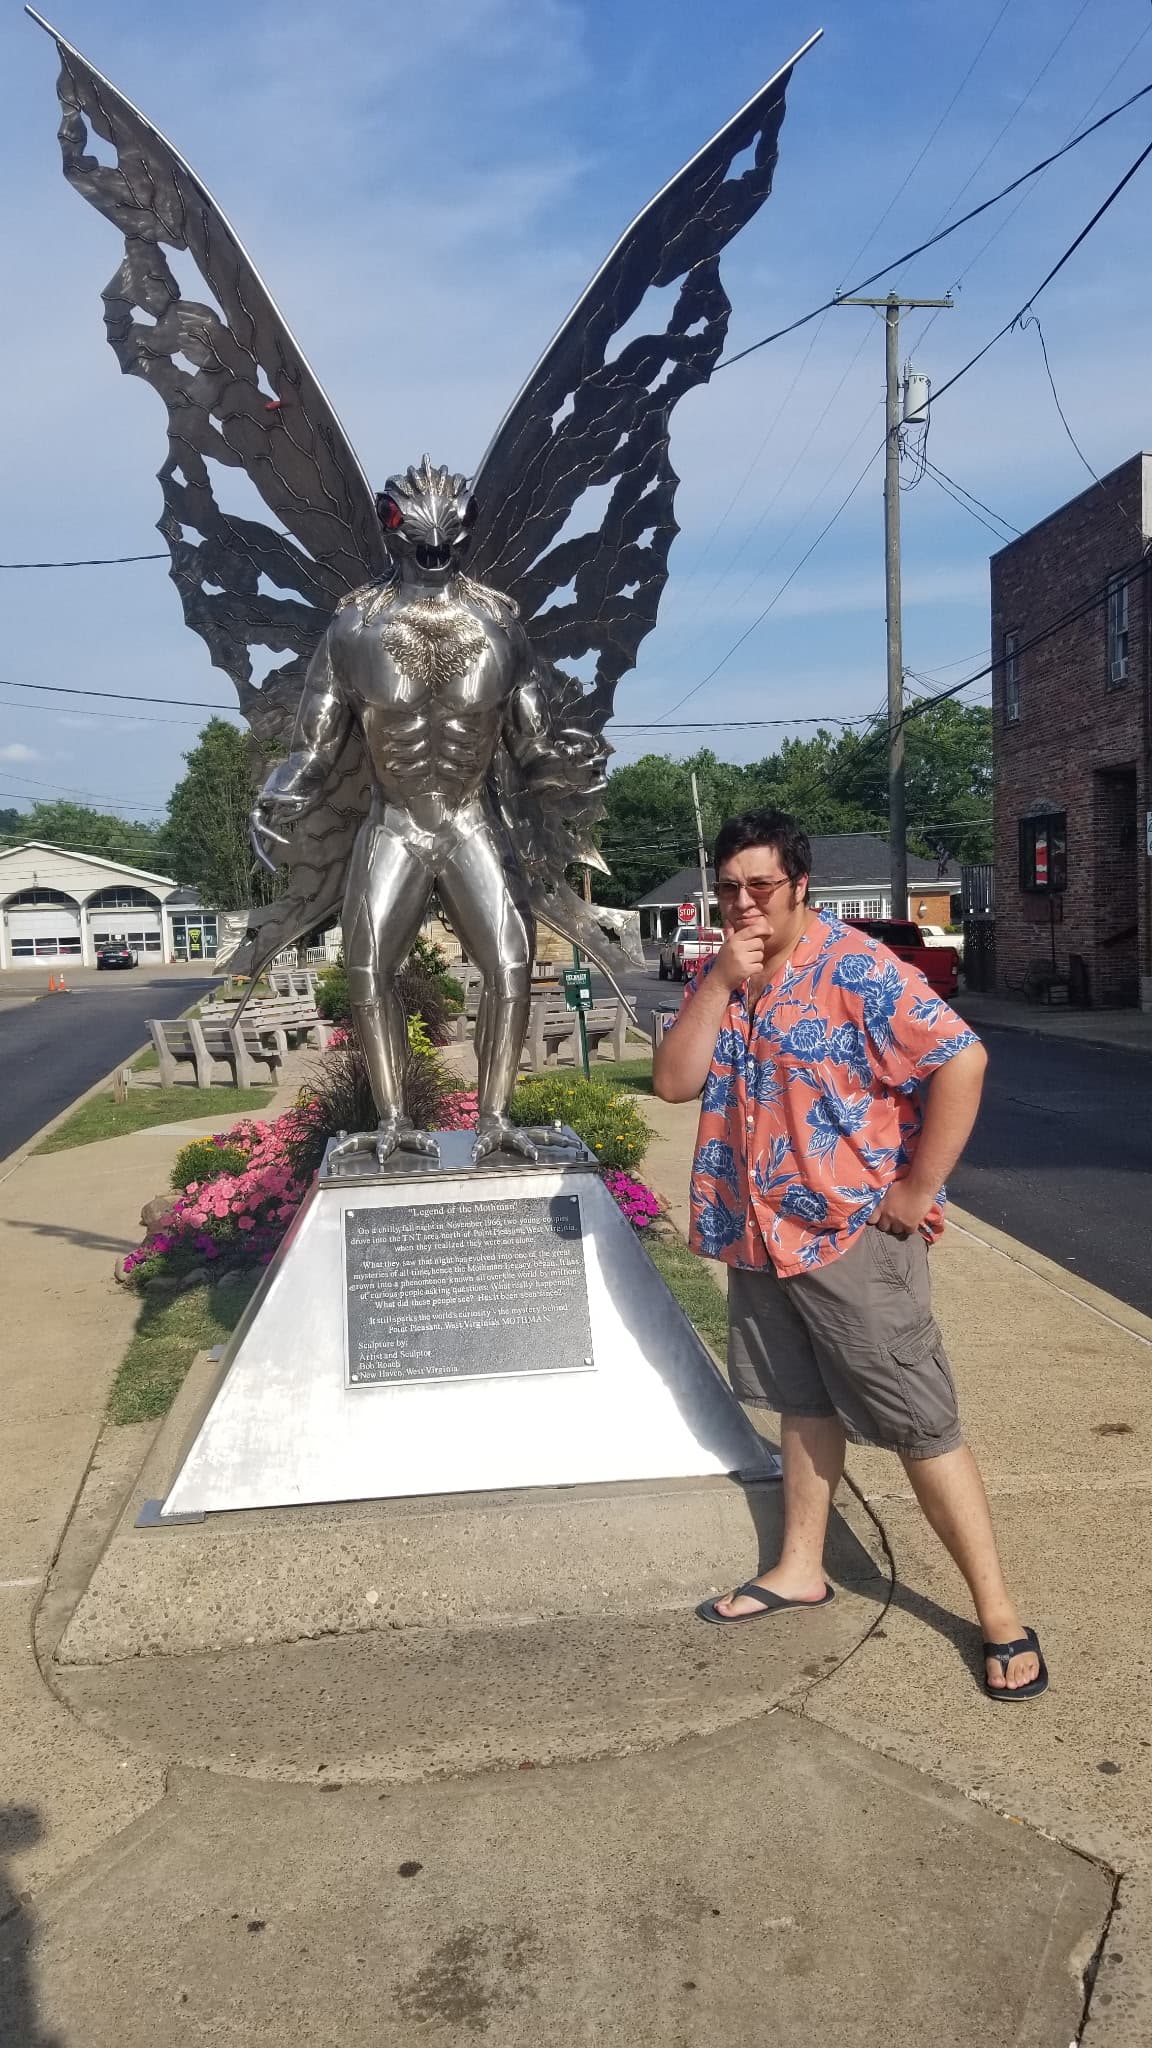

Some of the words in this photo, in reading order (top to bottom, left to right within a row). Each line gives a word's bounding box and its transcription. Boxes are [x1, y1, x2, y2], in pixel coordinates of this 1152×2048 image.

[680, 909, 695, 917] STOP
[408, 1207, 444, 1217] "Legend
[474, 1202, 518, 1212] Mothman"
[416, 1223, 435, 1232] night
[542, 1215, 568, 1224] couples
[416, 1243, 431, 1251] they
[434, 1240, 464, 1249] realized
[466, 1240, 481, 1248] they
[384, 1260, 399, 1268] they
[434, 1256, 454, 1265] night
[468, 1253, 496, 1262] evolved
[552, 1248, 570, 1258] great
[354, 1271, 388, 1281] mysteries
[468, 1264, 502, 1272] Mothman
[505, 1262, 531, 1271] Legacy
[349, 1284, 374, 1292] grown
[400, 1278, 446, 1288] phenomenon
[400, 1288, 424, 1298] people
[426, 1287, 450, 1295] asking
[491, 1282, 510, 1290] What
[512, 1280, 532, 1289] really
[375, 1300, 395, 1308] What
[432, 1296, 456, 1306] people
[377, 1315, 392, 1323] still
[392, 1314, 418, 1324] sparks
[458, 1309, 490, 1318] curiosity
[511, 1306, 540, 1316] mystery
[542, 1303, 568, 1312] behind
[389, 1325, 408, 1333] Point
[445, 1321, 462, 1329] West
[358, 1341, 394, 1350] Sculpture
[360, 1352, 382, 1360] Artist
[400, 1350, 432, 1359] Sculptor
[360, 1362, 374, 1370] Bob
[378, 1360, 400, 1368] Roach
[406, 1367, 424, 1375] West
[426, 1365, 458, 1375] Virginia
